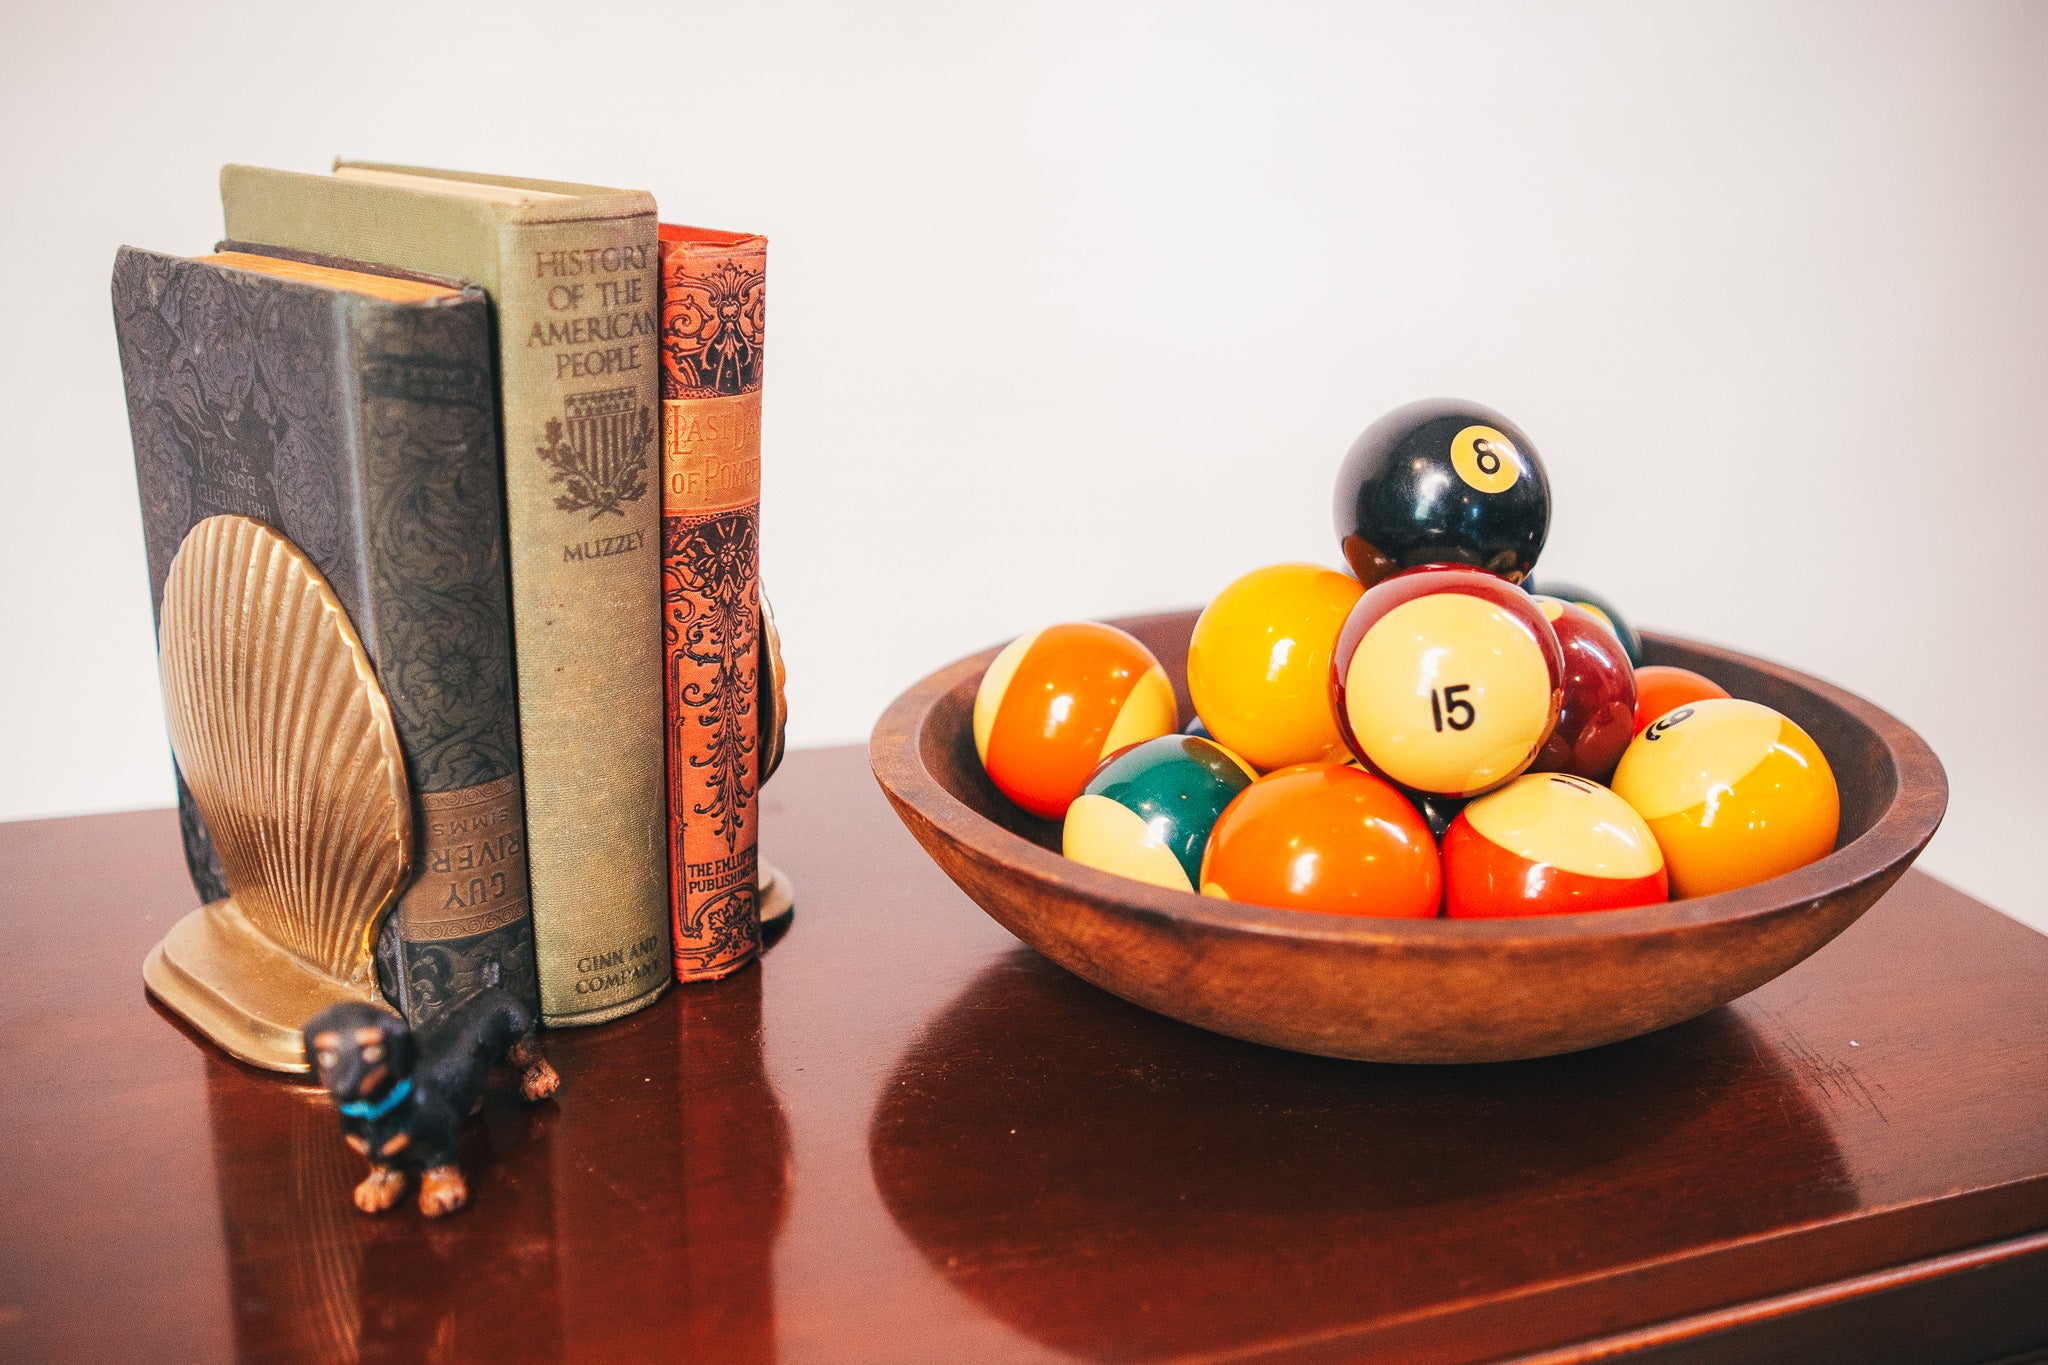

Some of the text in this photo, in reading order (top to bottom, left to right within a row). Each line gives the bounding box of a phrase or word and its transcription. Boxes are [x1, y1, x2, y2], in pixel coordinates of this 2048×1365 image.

[536, 243, 650, 278] HISTORY
[548, 278, 643, 311] OF THE
[526, 307, 657, 347] AMERICAN
[555, 345, 643, 380] PEOPLE
[1472, 438, 1501, 475] 8
[671, 472, 700, 495] OF
[563, 529, 646, 563] MUZZEY
[1431, 684, 1476, 733] 15
[431, 806, 509, 837] SIMMS
[687, 862, 714, 878] THE
[442, 871, 506, 910] GUY
[577, 935, 658, 974] GINN AND
[575, 959, 659, 994] COMPANY
